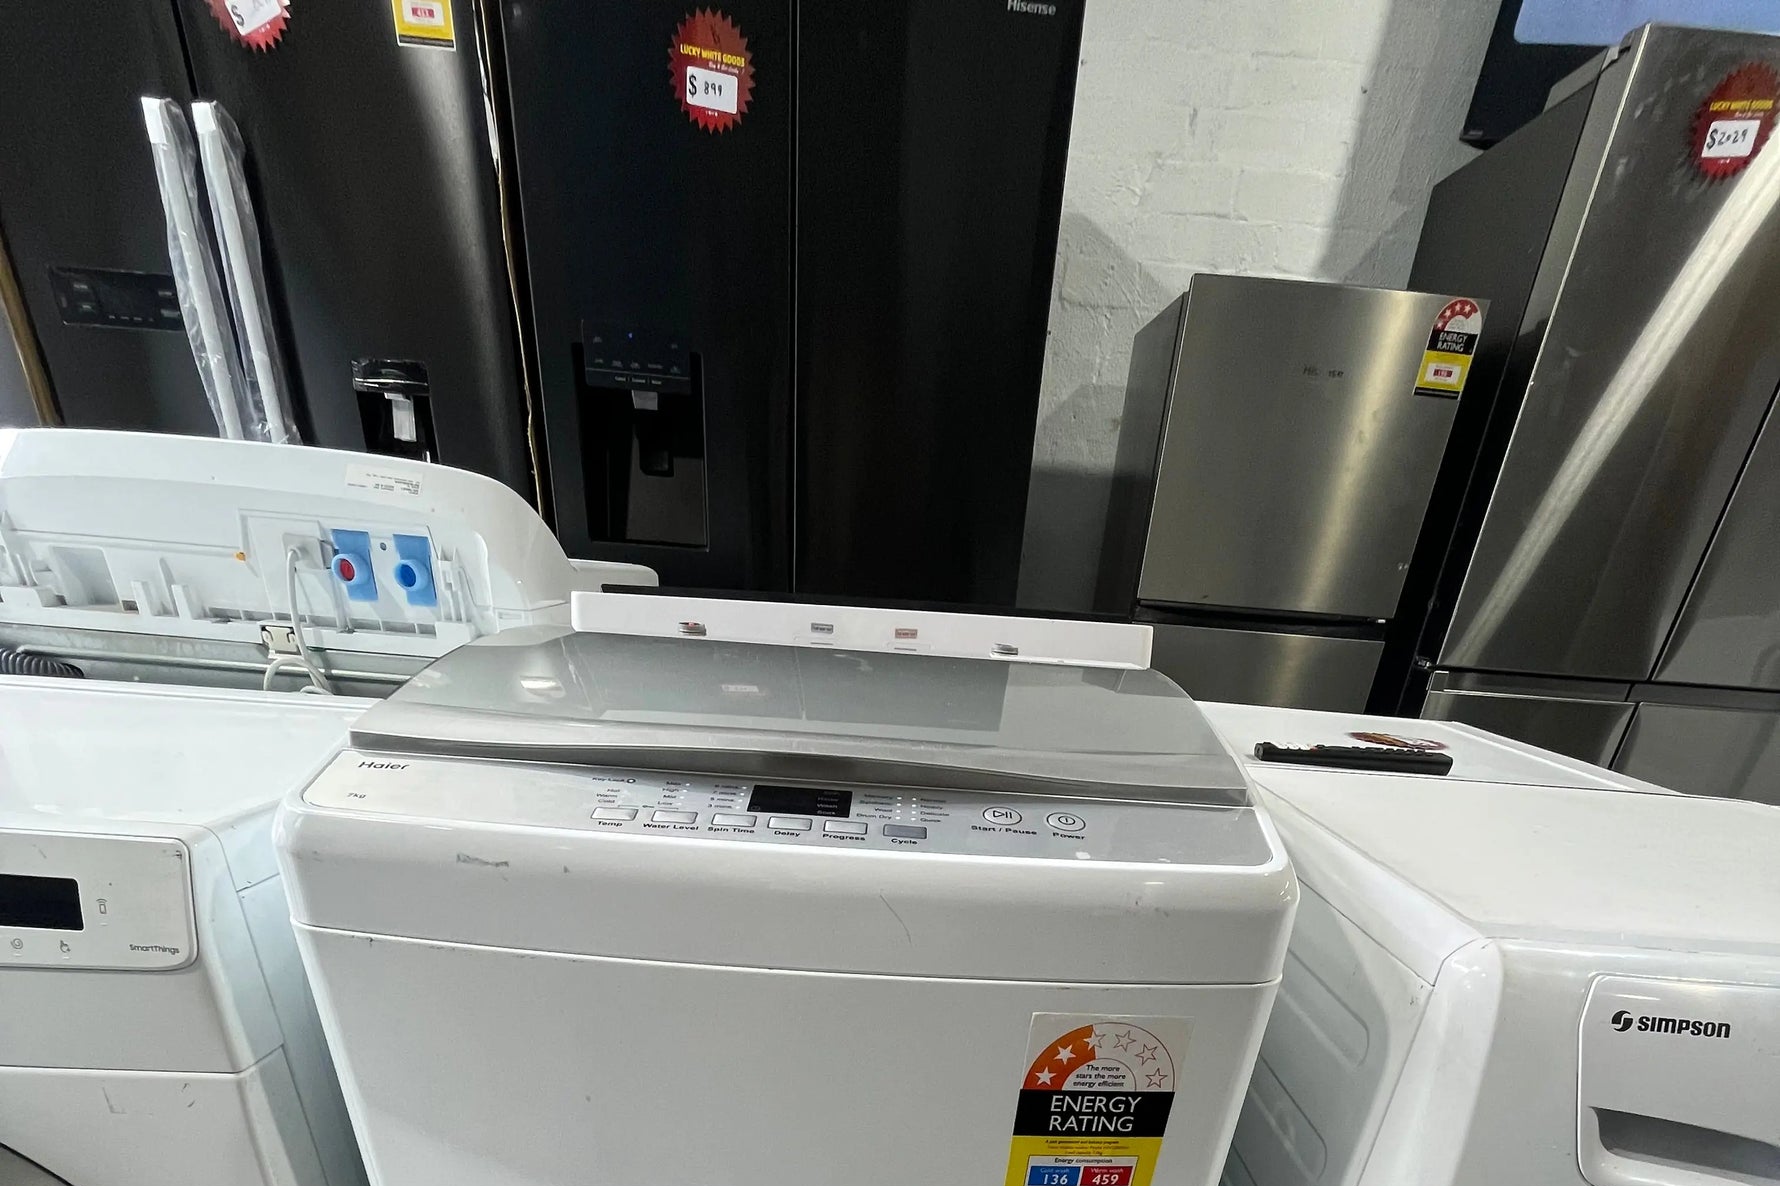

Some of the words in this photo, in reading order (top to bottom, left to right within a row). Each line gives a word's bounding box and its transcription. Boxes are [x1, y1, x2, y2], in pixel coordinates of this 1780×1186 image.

[680, 43, 701, 57] LUCKY
[701, 49, 722, 62] WHITE
[722, 53, 745, 67] GOODS
[688, 73, 697, 99] $
[1440, 332, 1468, 343] ENERGY
[1437, 341, 1464, 353] RATING
[358, 761, 410, 770] Haier
[774, 830, 801, 838] Delay
[822, 833, 866, 841] Progress
[1052, 832, 1086, 840] Power
[129, 944, 180, 956] SmartThings
[1086, 1064, 1100, 1072] The
[1073, 1081, 1096, 1089] energy
[1050, 1095, 1142, 1113] ENERGY
[1049, 1115, 1135, 1132] RATING
[1054, 1157, 1075, 1165] Energy
[1042, 1174, 1068, 1185] 136
[1092, 1174, 1119, 1185] 459
